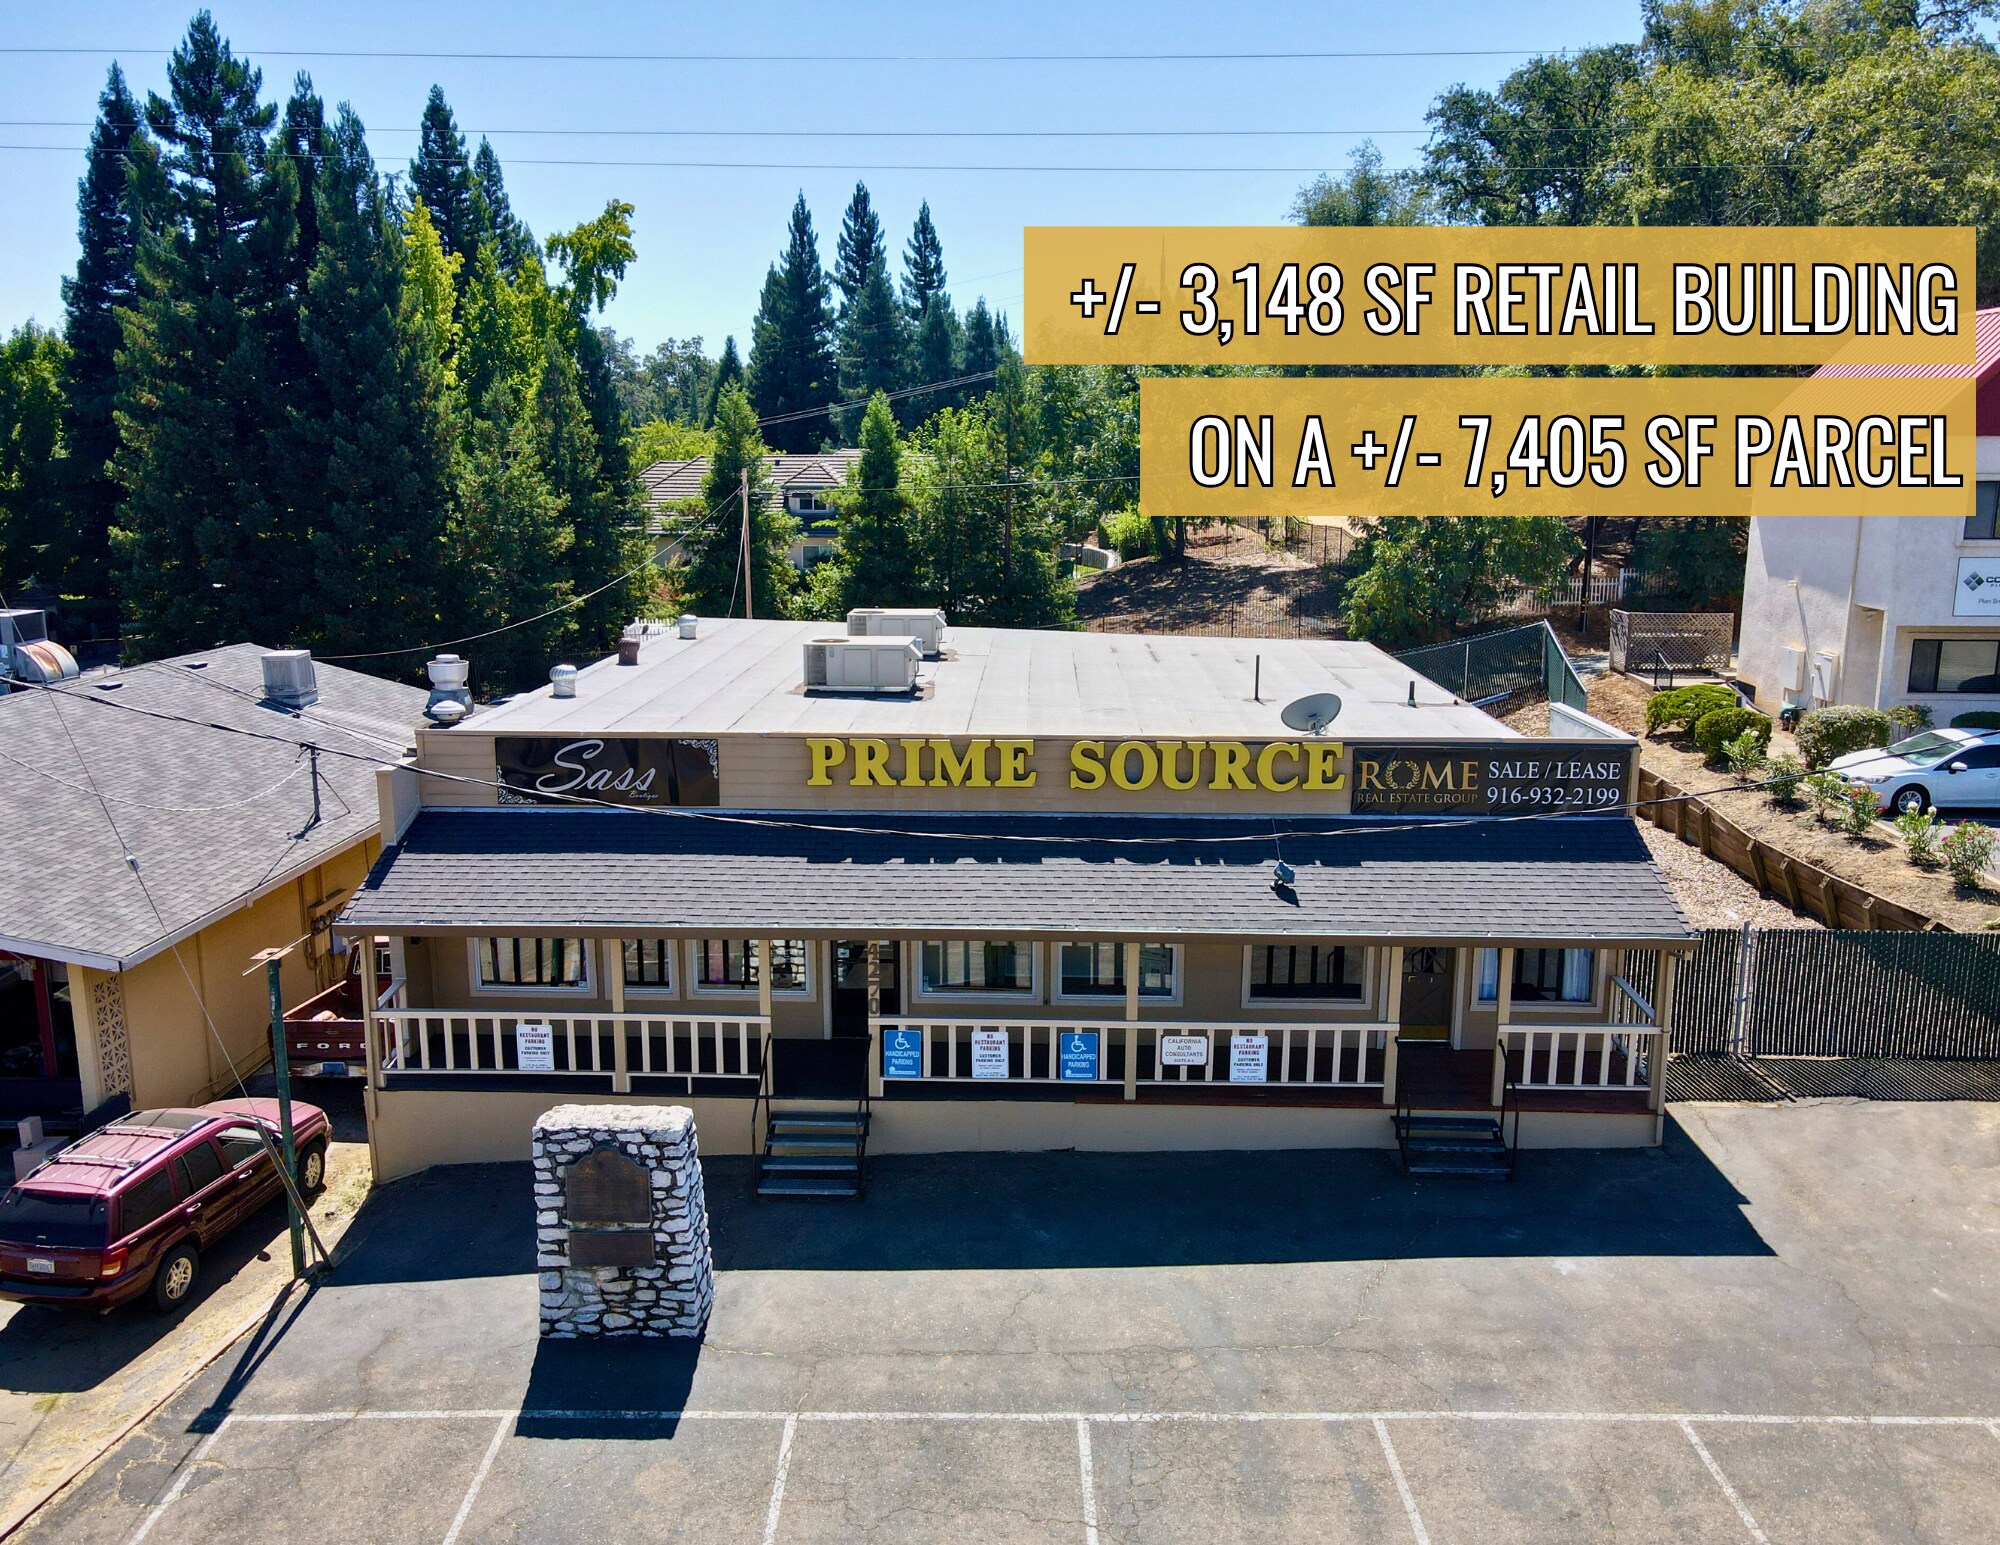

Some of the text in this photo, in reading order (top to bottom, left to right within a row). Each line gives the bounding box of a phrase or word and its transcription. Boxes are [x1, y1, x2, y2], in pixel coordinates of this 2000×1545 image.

[535, 739, 656, 792] Sass
[806, 738, 1347, 793] PRIME SOURCE
[1359, 760, 1479, 790] ROME
[1488, 761, 1621, 780] SALE / LEASE
[1357, 792, 1478, 804] REAL ESTATE GROUP
[1486, 786, 1621, 806] 916-932-2199
[867, 943, 880, 1015] 4270
[885, 1050, 920, 1058] HANDICAPPED
[891, 1058, 913, 1066] PARKING
